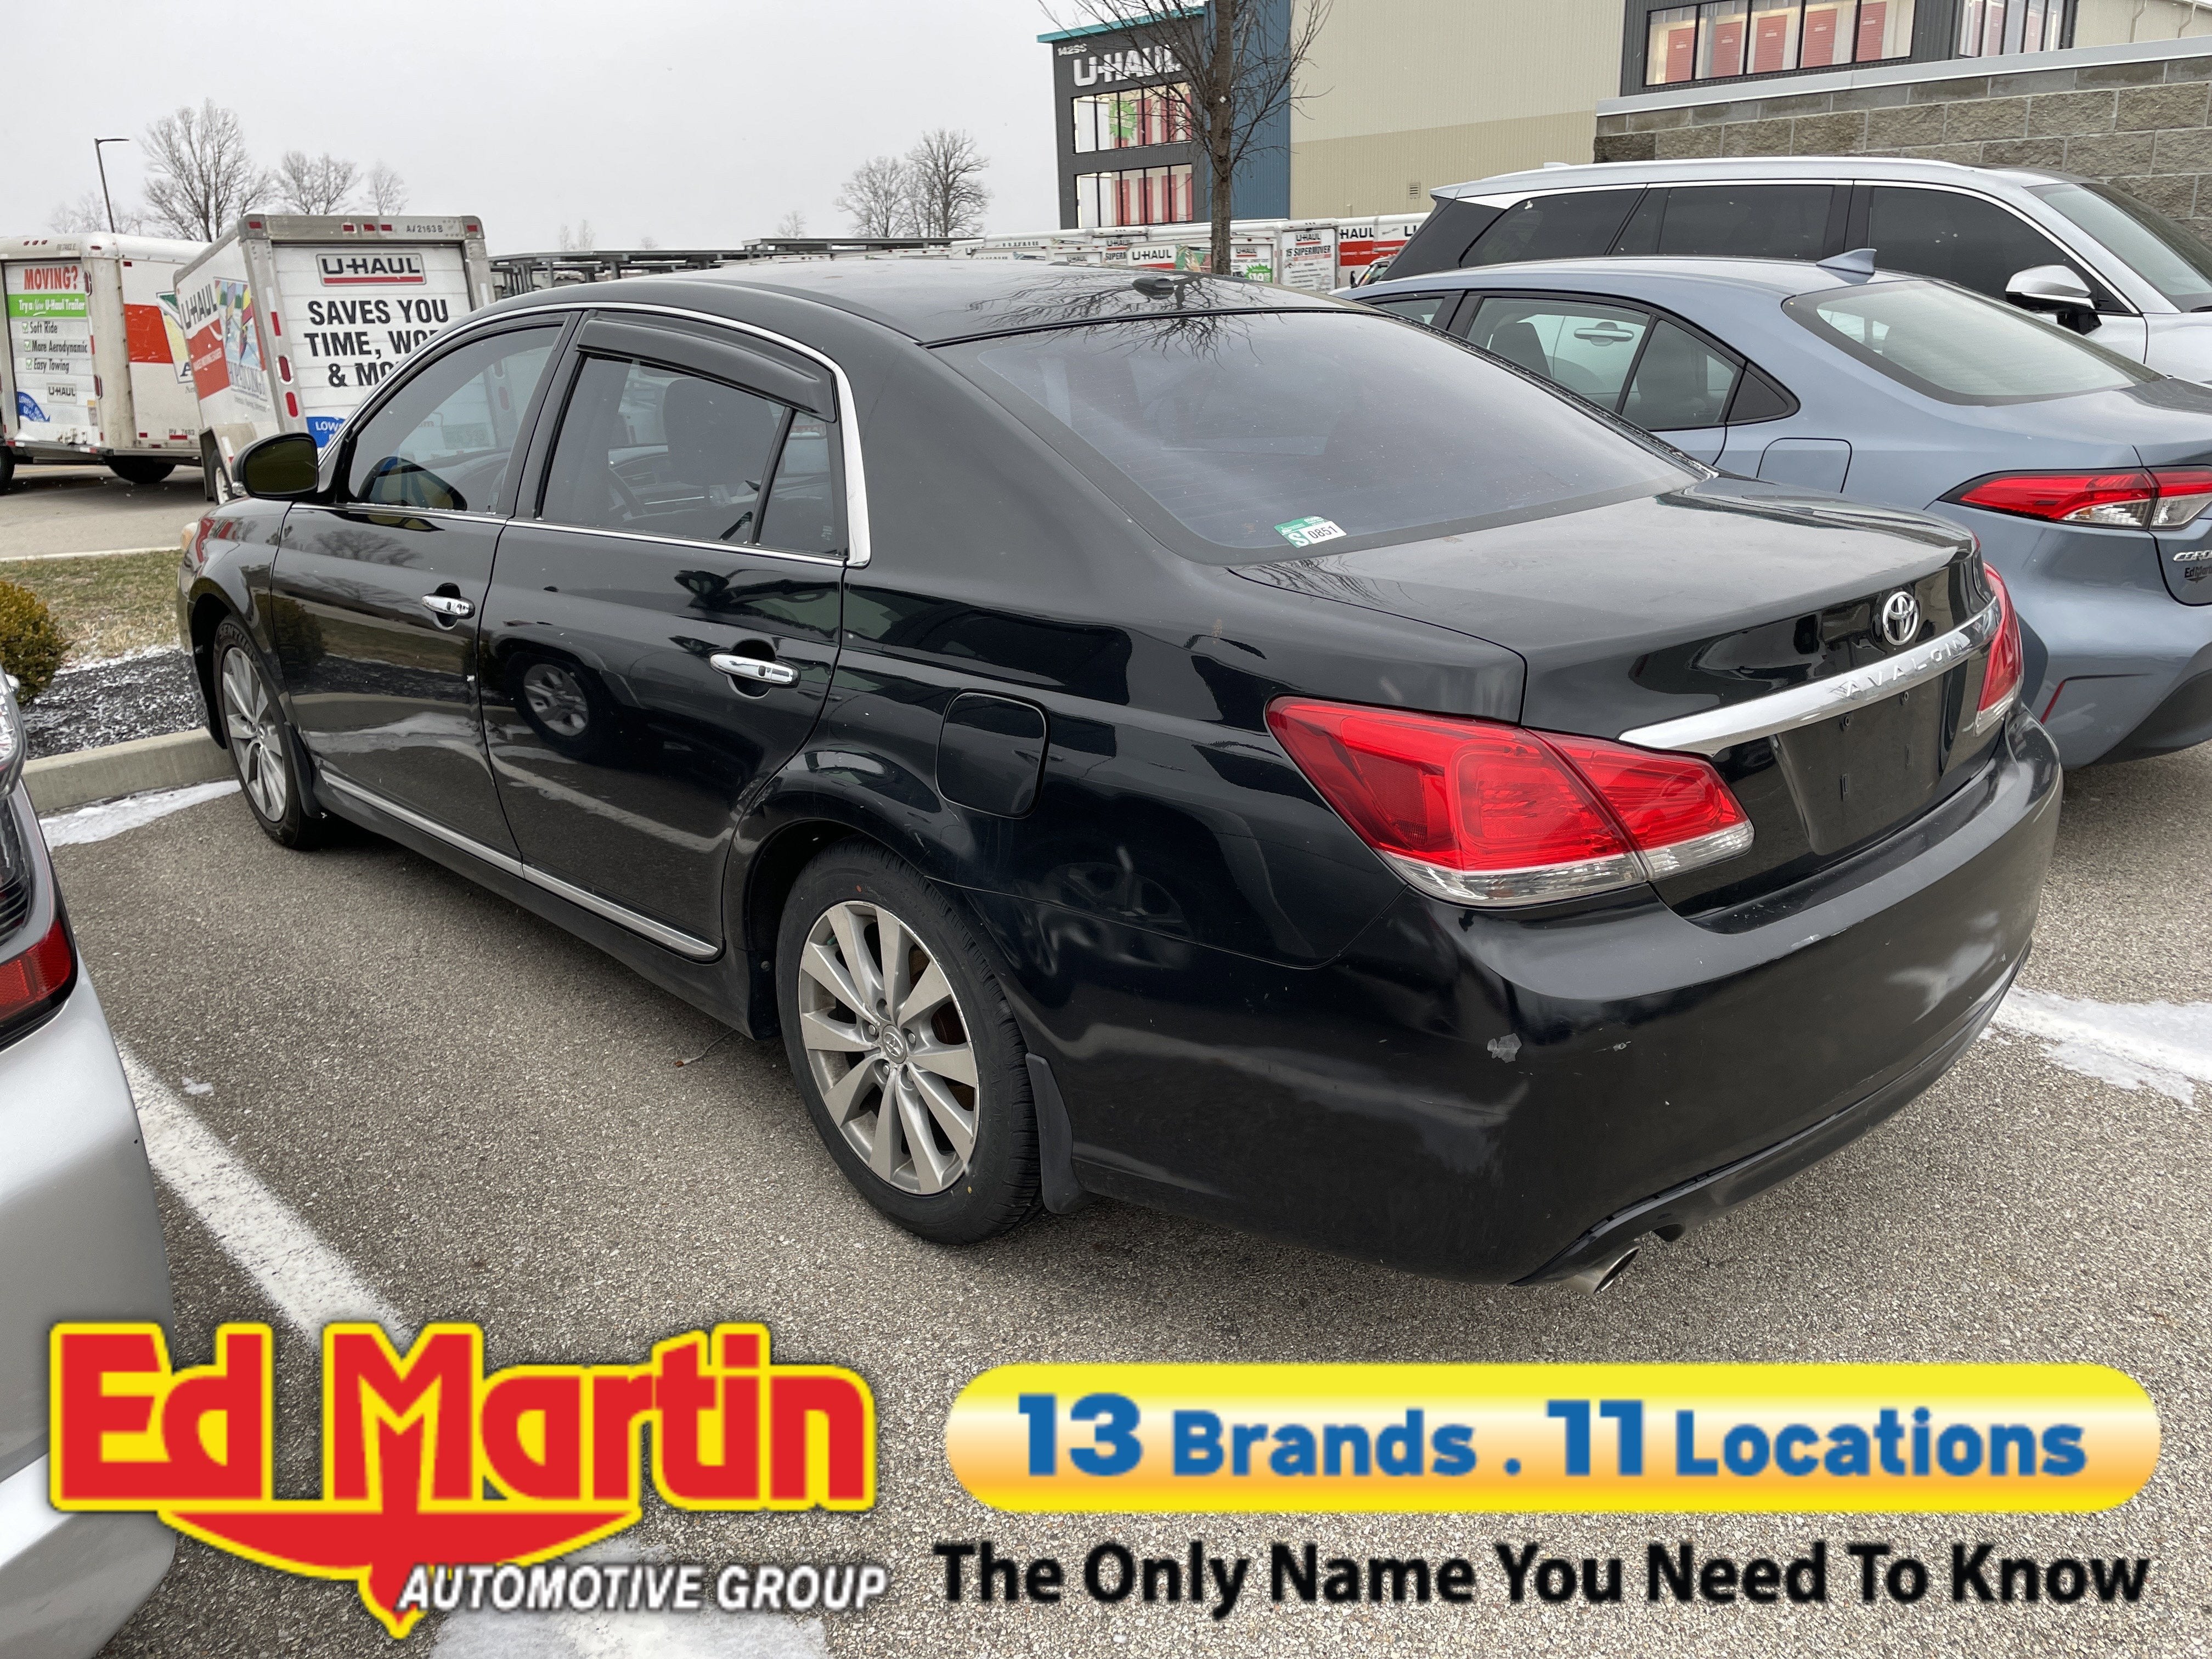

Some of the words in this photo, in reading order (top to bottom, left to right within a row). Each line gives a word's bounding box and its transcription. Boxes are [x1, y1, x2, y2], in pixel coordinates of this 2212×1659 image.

[1132, 250, 1172, 261] U-HAUL
[321, 258, 420, 274] U-HAUL
[24, 266, 78, 290] MOVING?
[182, 284, 218, 329] U-HAUL
[307, 300, 391, 325] SAVES
[396, 299, 449, 323] YOU
[30, 321, 42, 334] Soft
[44, 321, 58, 334] Ride
[32, 340, 47, 352] More
[48, 340, 87, 356] Aerodynamic
[304, 331, 382, 359] TIME,
[388, 330, 439, 354] WO
[34, 358, 47, 374] Easy
[48, 358, 70, 374] Towing
[328, 363, 349, 387] &
[354, 361, 399, 386] MO
[48, 386, 76, 396] U-HAUL
[315, 421, 342, 431] LOW
[1288, 532, 1309, 546] S
[1307, 526, 1338, 539] 0851
[1846, 638, 1965, 697] AVALON
